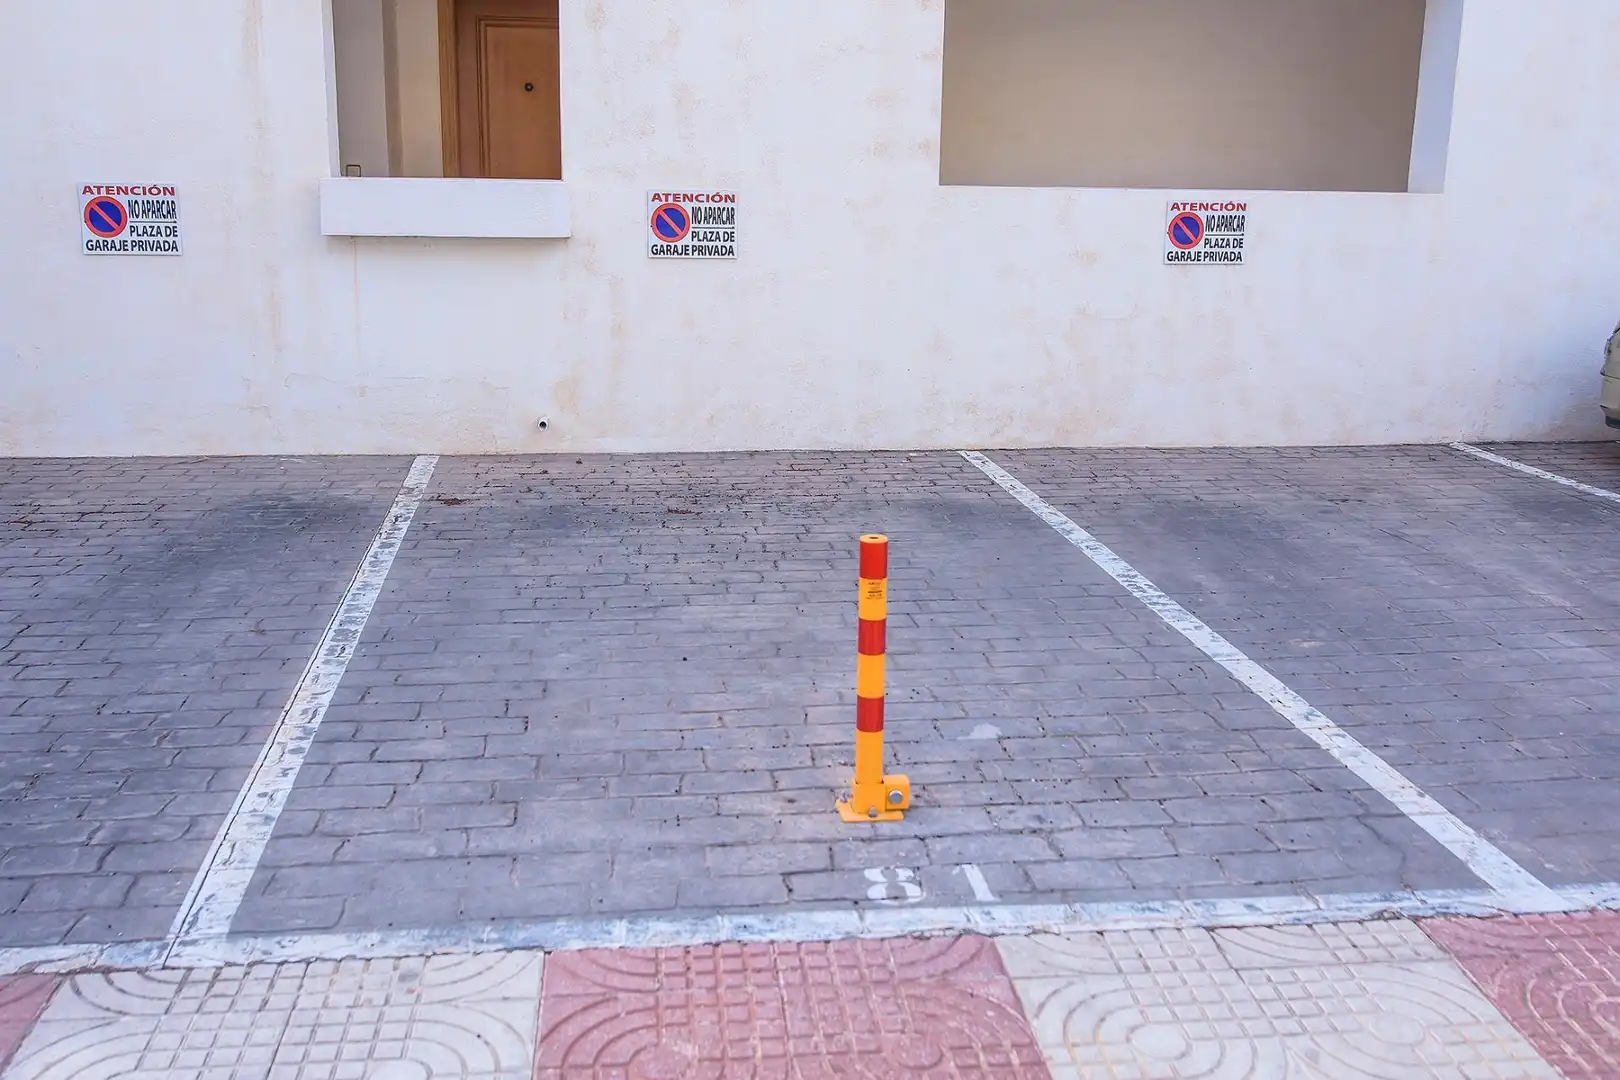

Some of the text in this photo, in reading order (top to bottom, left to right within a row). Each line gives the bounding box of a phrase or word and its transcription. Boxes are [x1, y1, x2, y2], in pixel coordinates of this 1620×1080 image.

[82, 184, 175, 196] ATENCIÓN
[651, 191, 735, 203] ATENCIÓN
[127, 199, 177, 219] NO APARCAR
[1170, 200, 1247, 211] ATENCIÓN
[691, 206, 735, 225] NO APARCAR
[1205, 214, 1245, 232] NO APARCAR
[129, 225, 178, 237] PLAZA DE
[691, 230, 735, 242] PLAZA DE
[85, 239, 179, 252] GARAJE PRIVADA
[1204, 237, 1244, 249] PLAZA DE
[651, 244, 735, 256] GARAJE PRIVADA
[1166, 251, 1242, 262] GARAJE PRIVADA
